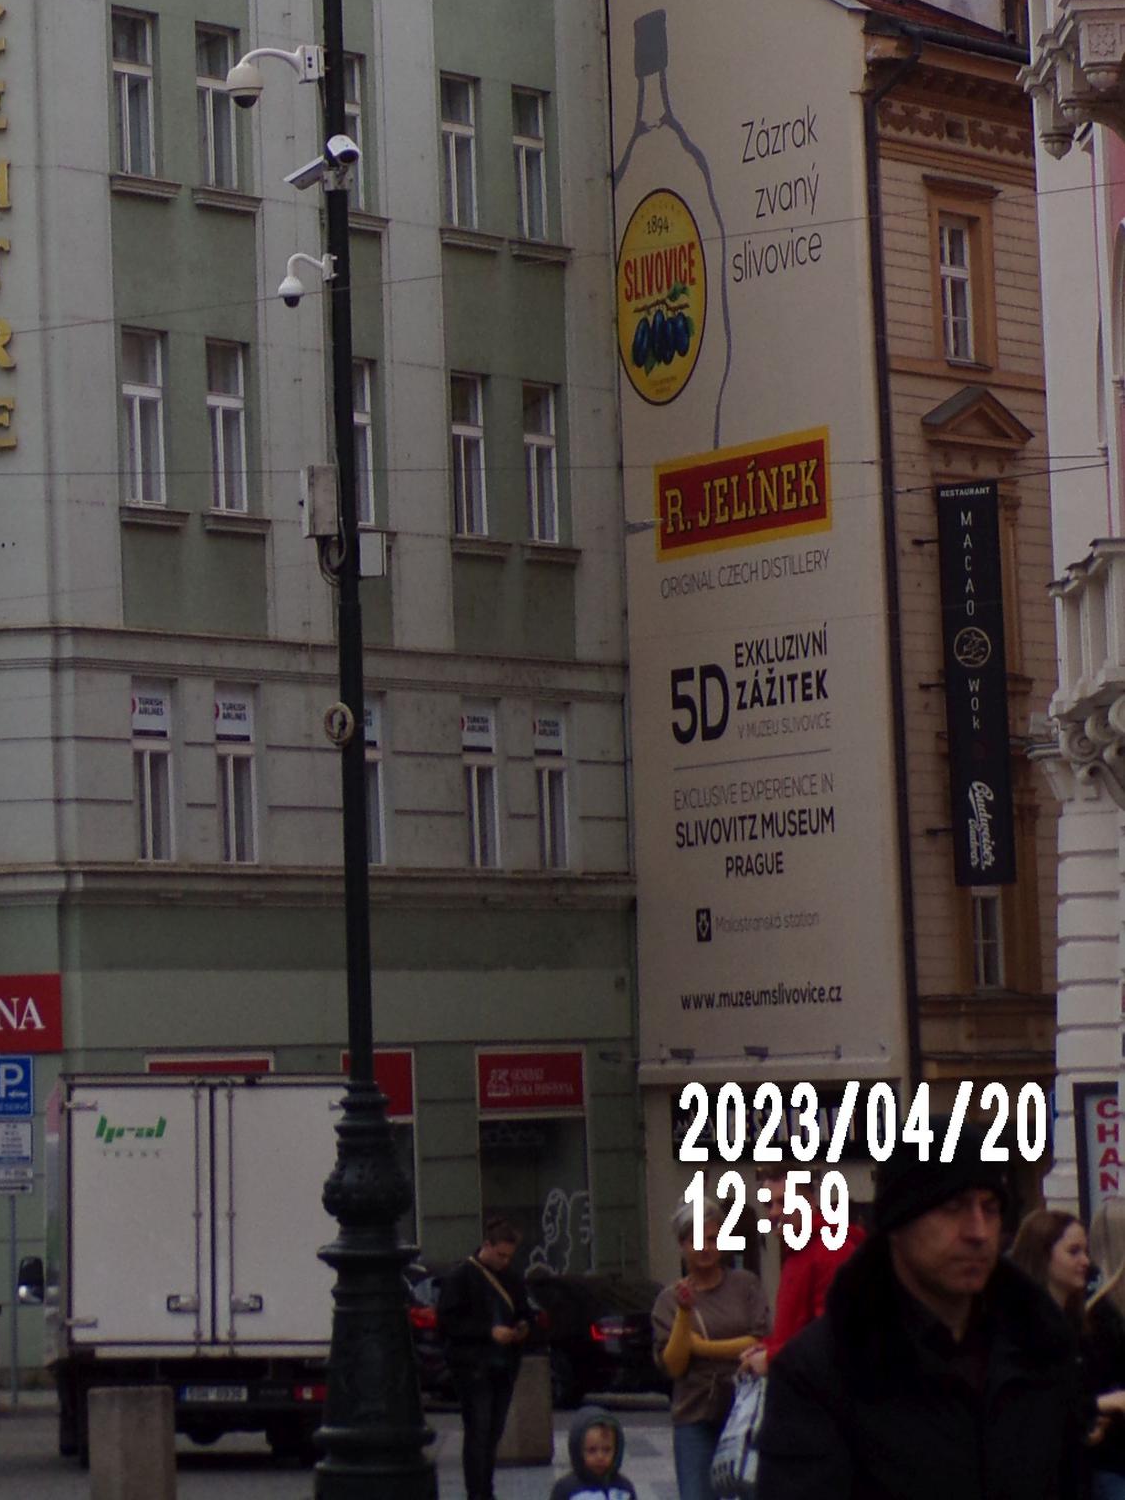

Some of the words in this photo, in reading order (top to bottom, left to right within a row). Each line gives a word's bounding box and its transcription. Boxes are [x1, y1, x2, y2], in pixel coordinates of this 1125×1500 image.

[742, 105, 818, 163] Zázrak
[755, 162, 819, 218] zvaný
[647, 214, 670, 236] 1894
[625, 242, 696, 302] SLIVOVICE
[732, 228, 822, 283] slivovice
[665, 487, 692, 534] R.
[698, 459, 820, 528] JELÍNEK
[940, 486, 990, 497] RESTAURANT
[660, 570, 715, 599] ORIGINAL
[718, 562, 759, 588] CZECH
[762, 549, 831, 581] DISTILLERY
[960, 511, 975, 616] MACAO
[734, 622, 828, 668] EXKLUZIVNÍ
[670, 663, 730, 745] 5D
[736, 666, 828, 711] ZÁŽITEK
[782, 712, 832, 735] SLIVOVICE
[674, 784, 737, 811] EXCLUSIVE
[741, 774, 818, 804] EXPERIENCE
[821, 773, 835, 794] IN
[675, 813, 758, 848] SLIVOVITZ
[761, 806, 835, 840] MUSEUM
[725, 851, 785, 879] PRAGUE
[784, 911, 820, 930] station
[680, 981, 843, 1011] www.muzeumslivovice.cz
